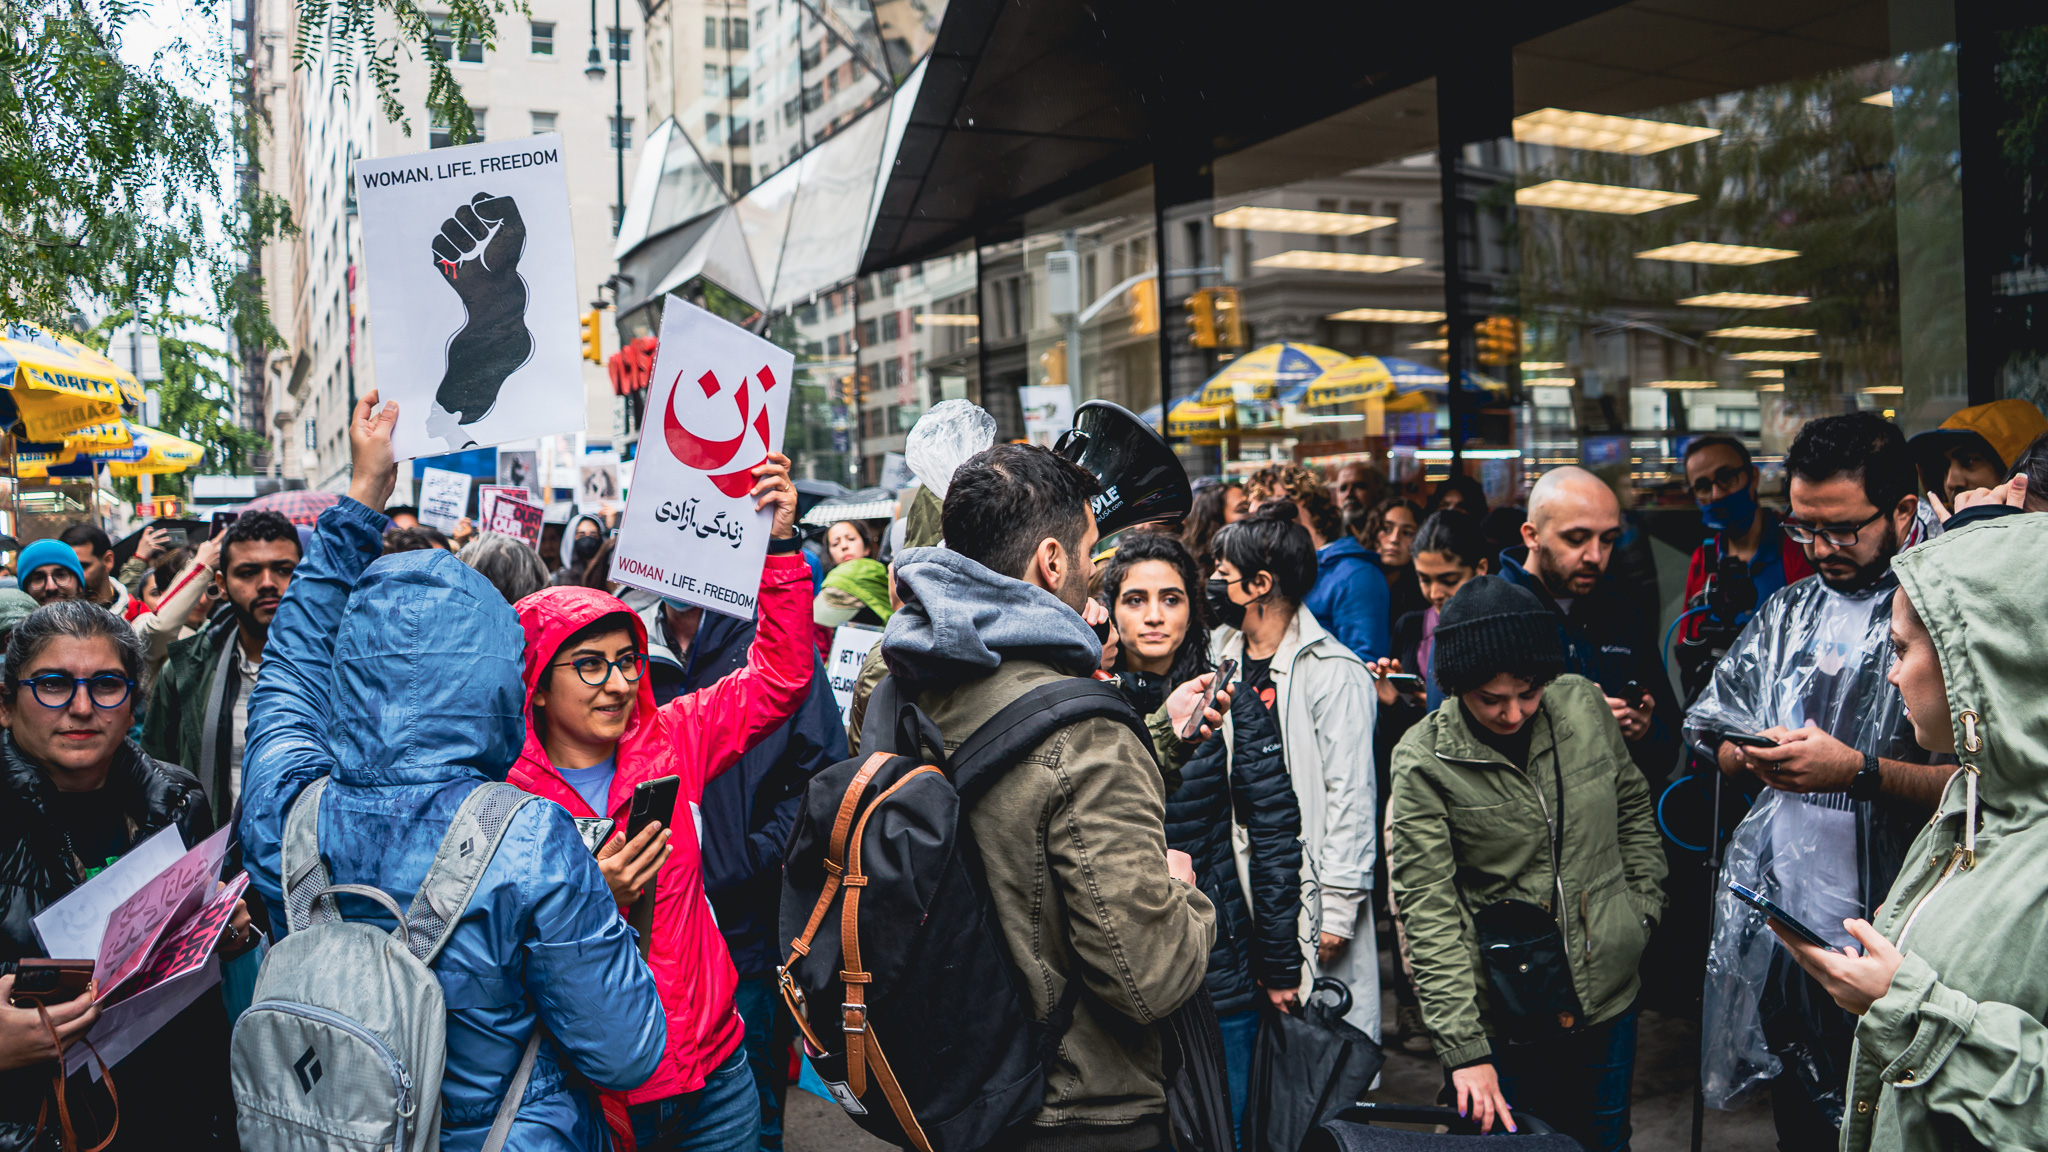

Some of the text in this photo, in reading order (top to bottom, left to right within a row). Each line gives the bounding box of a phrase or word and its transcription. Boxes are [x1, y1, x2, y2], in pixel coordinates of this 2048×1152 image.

[480, 148, 558, 174] FREEDOM
[664, 364, 777, 499] زن
[703, 583, 755, 610] FREEDOM
